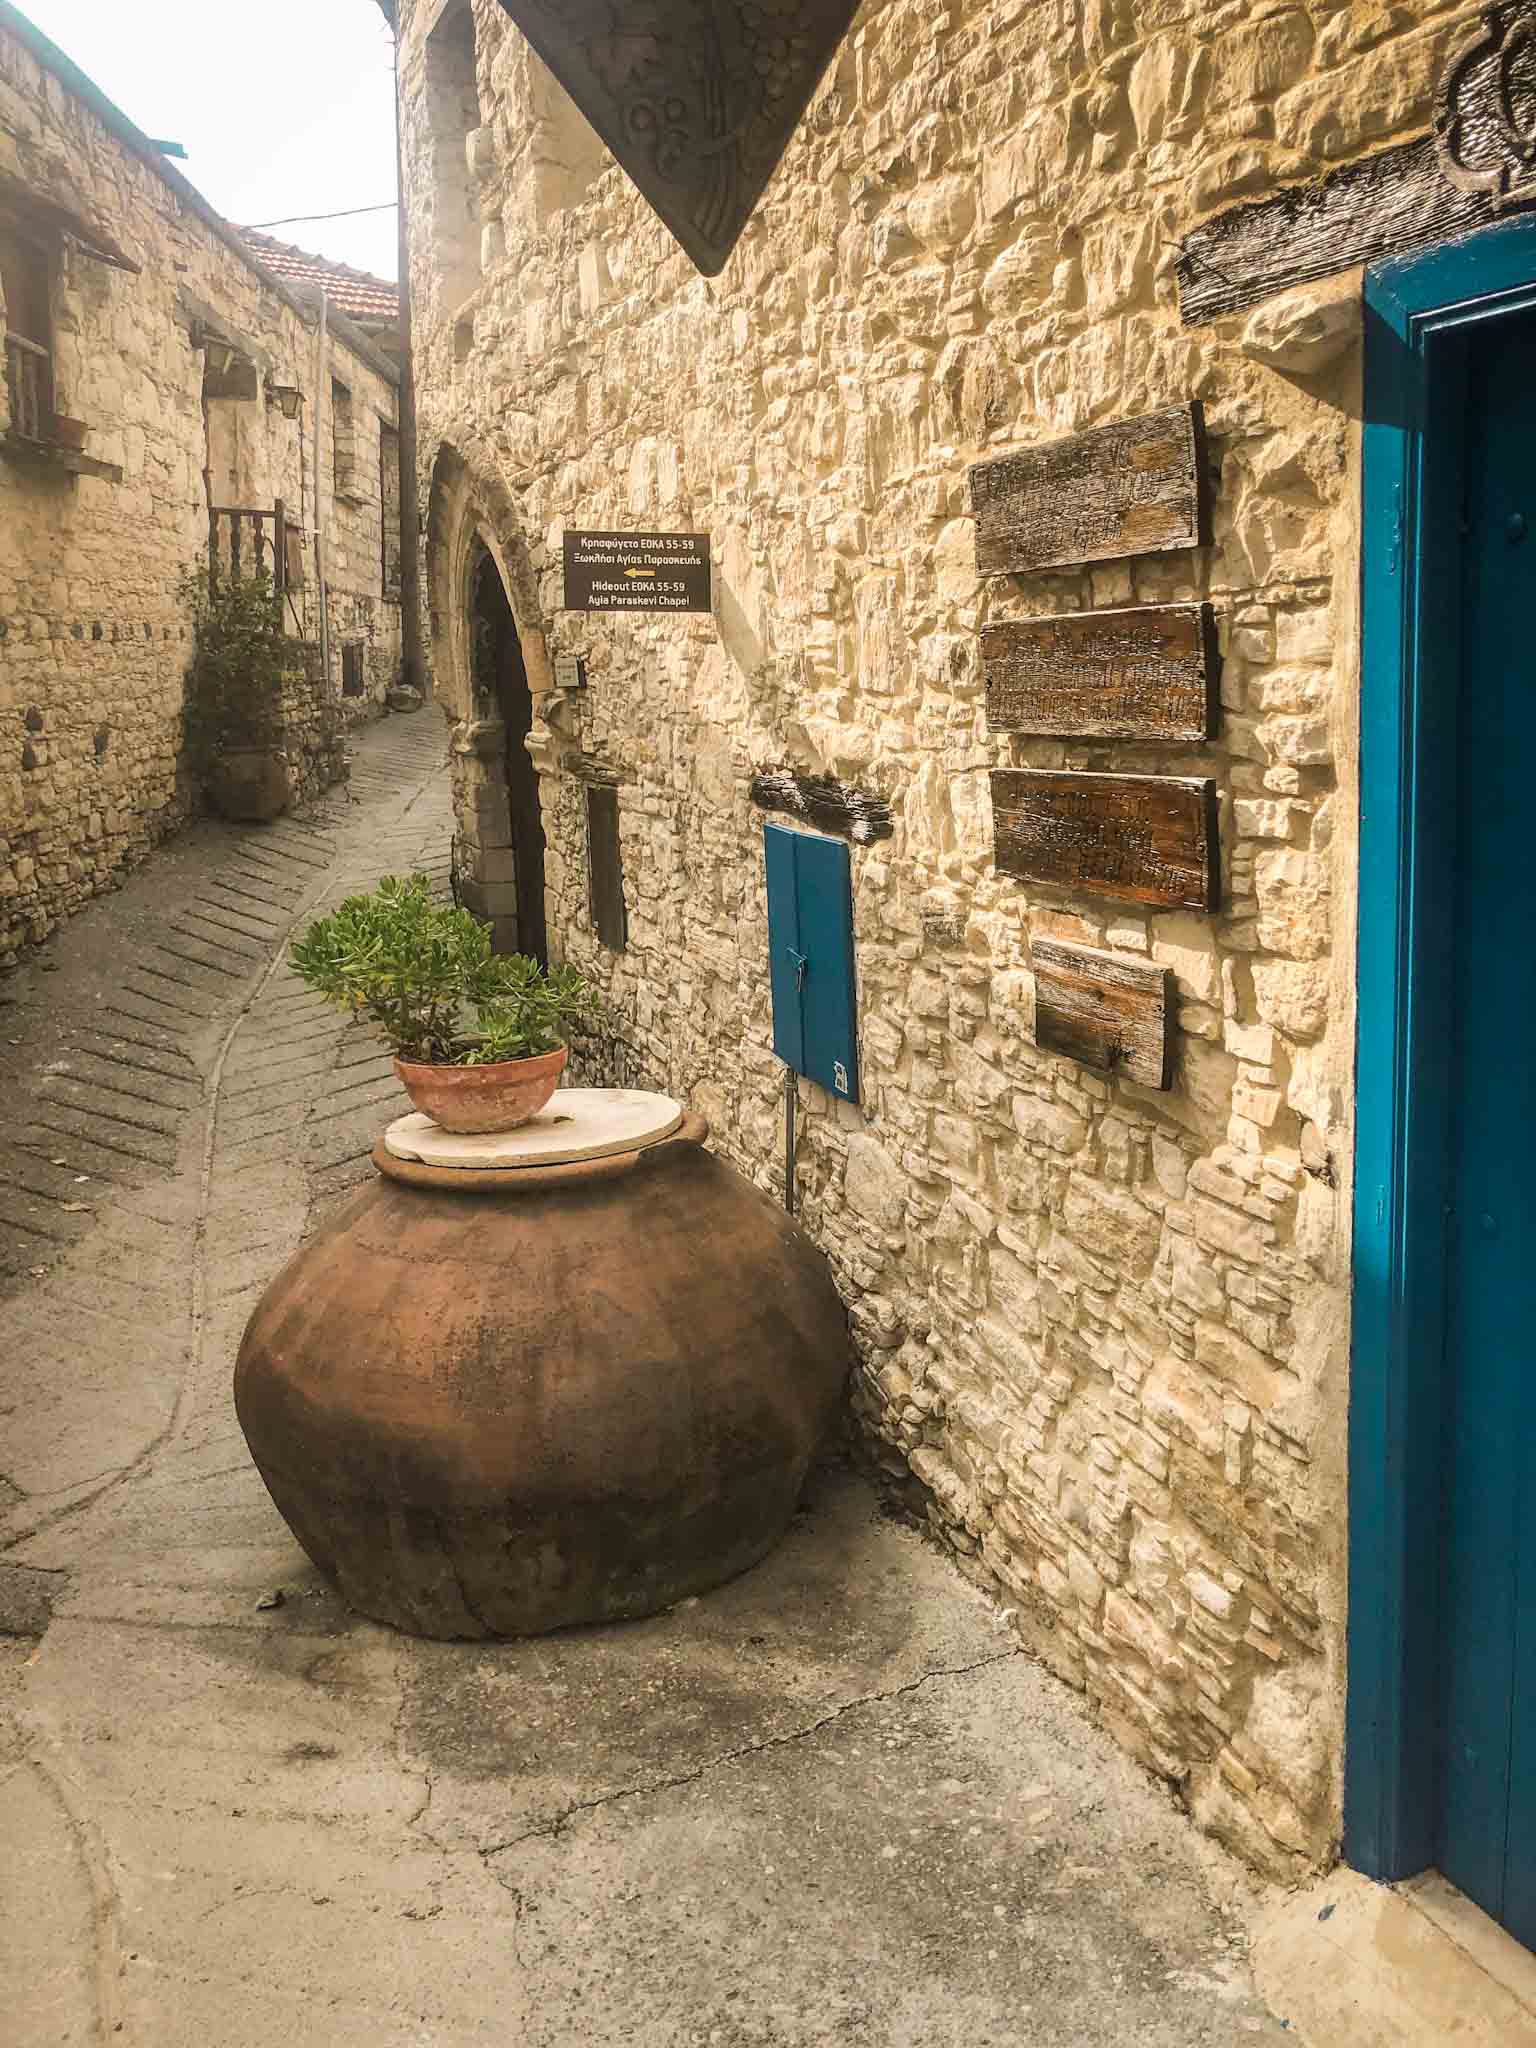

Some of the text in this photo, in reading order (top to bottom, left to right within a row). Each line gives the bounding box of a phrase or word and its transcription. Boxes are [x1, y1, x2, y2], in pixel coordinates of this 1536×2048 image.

[665, 539, 695, 550] 55-59
[574, 552, 702, 567] Ξωκλήσι Αγίας Παρασκευής
[592, 580, 630, 592] Hideout
[657, 582, 686, 592] 55-59
[610, 594, 657, 606] Paraskevi
[658, 595, 690, 608] Chapel
